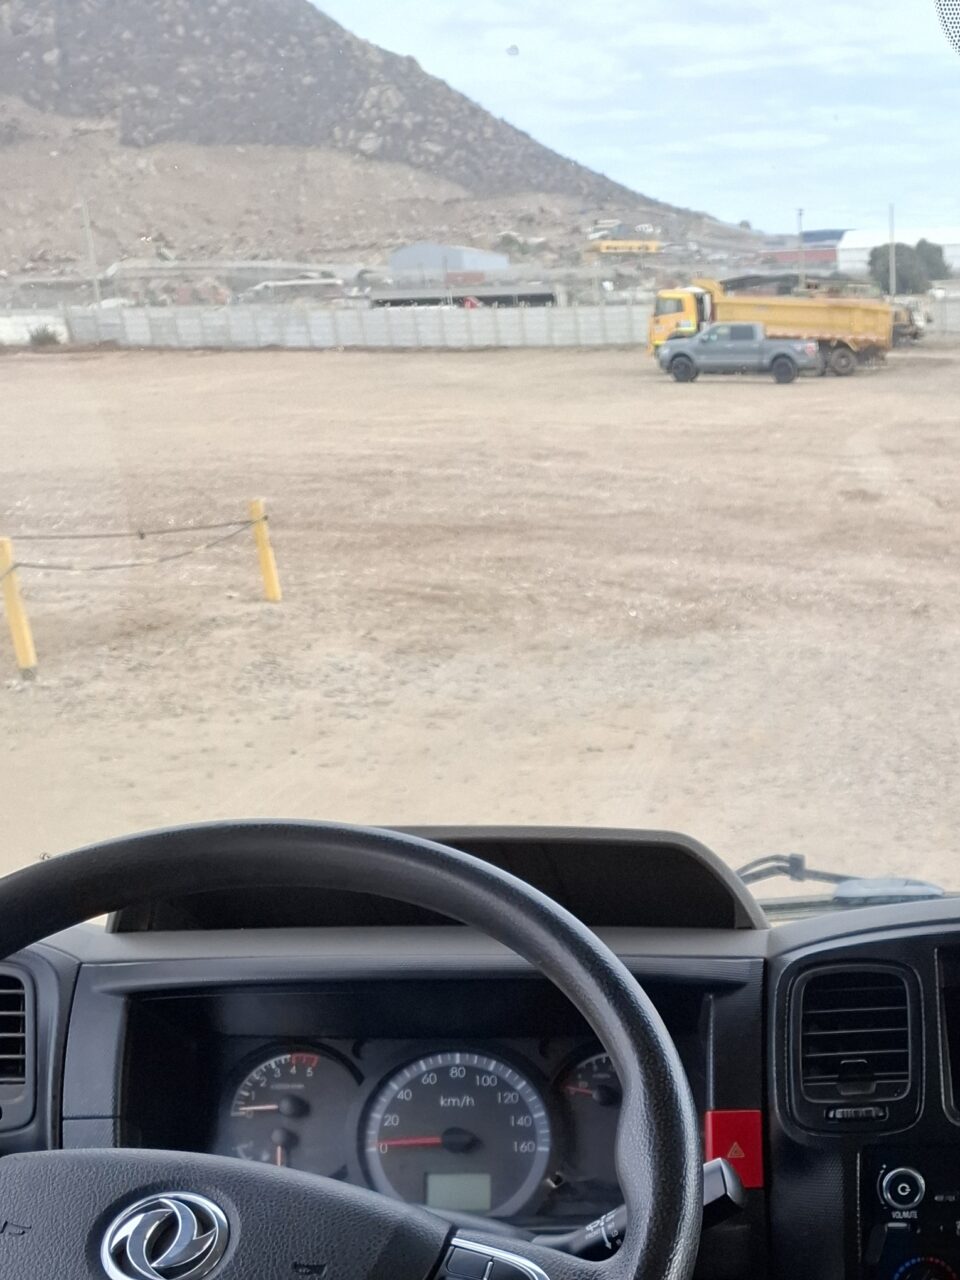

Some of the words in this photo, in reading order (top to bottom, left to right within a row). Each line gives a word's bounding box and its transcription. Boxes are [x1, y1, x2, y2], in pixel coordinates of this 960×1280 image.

[273, 1068, 281, 1078] 3
[289, 1065, 297, 1075] 4
[305, 1067, 314, 1077] 5
[449, 1066, 466, 1079] 80
[421, 1073, 438, 1086] 60
[474, 1074, 498, 1087] 100
[397, 1089, 413, 1101] 40
[439, 1094, 476, 1108] km/h
[497, 1091, 519, 1104] 120
[383, 1114, 400, 1128] 20
[510, 1115, 533, 1128] 140
[379, 1142, 388, 1155] 0
[512, 1140, 536, 1154] 160
